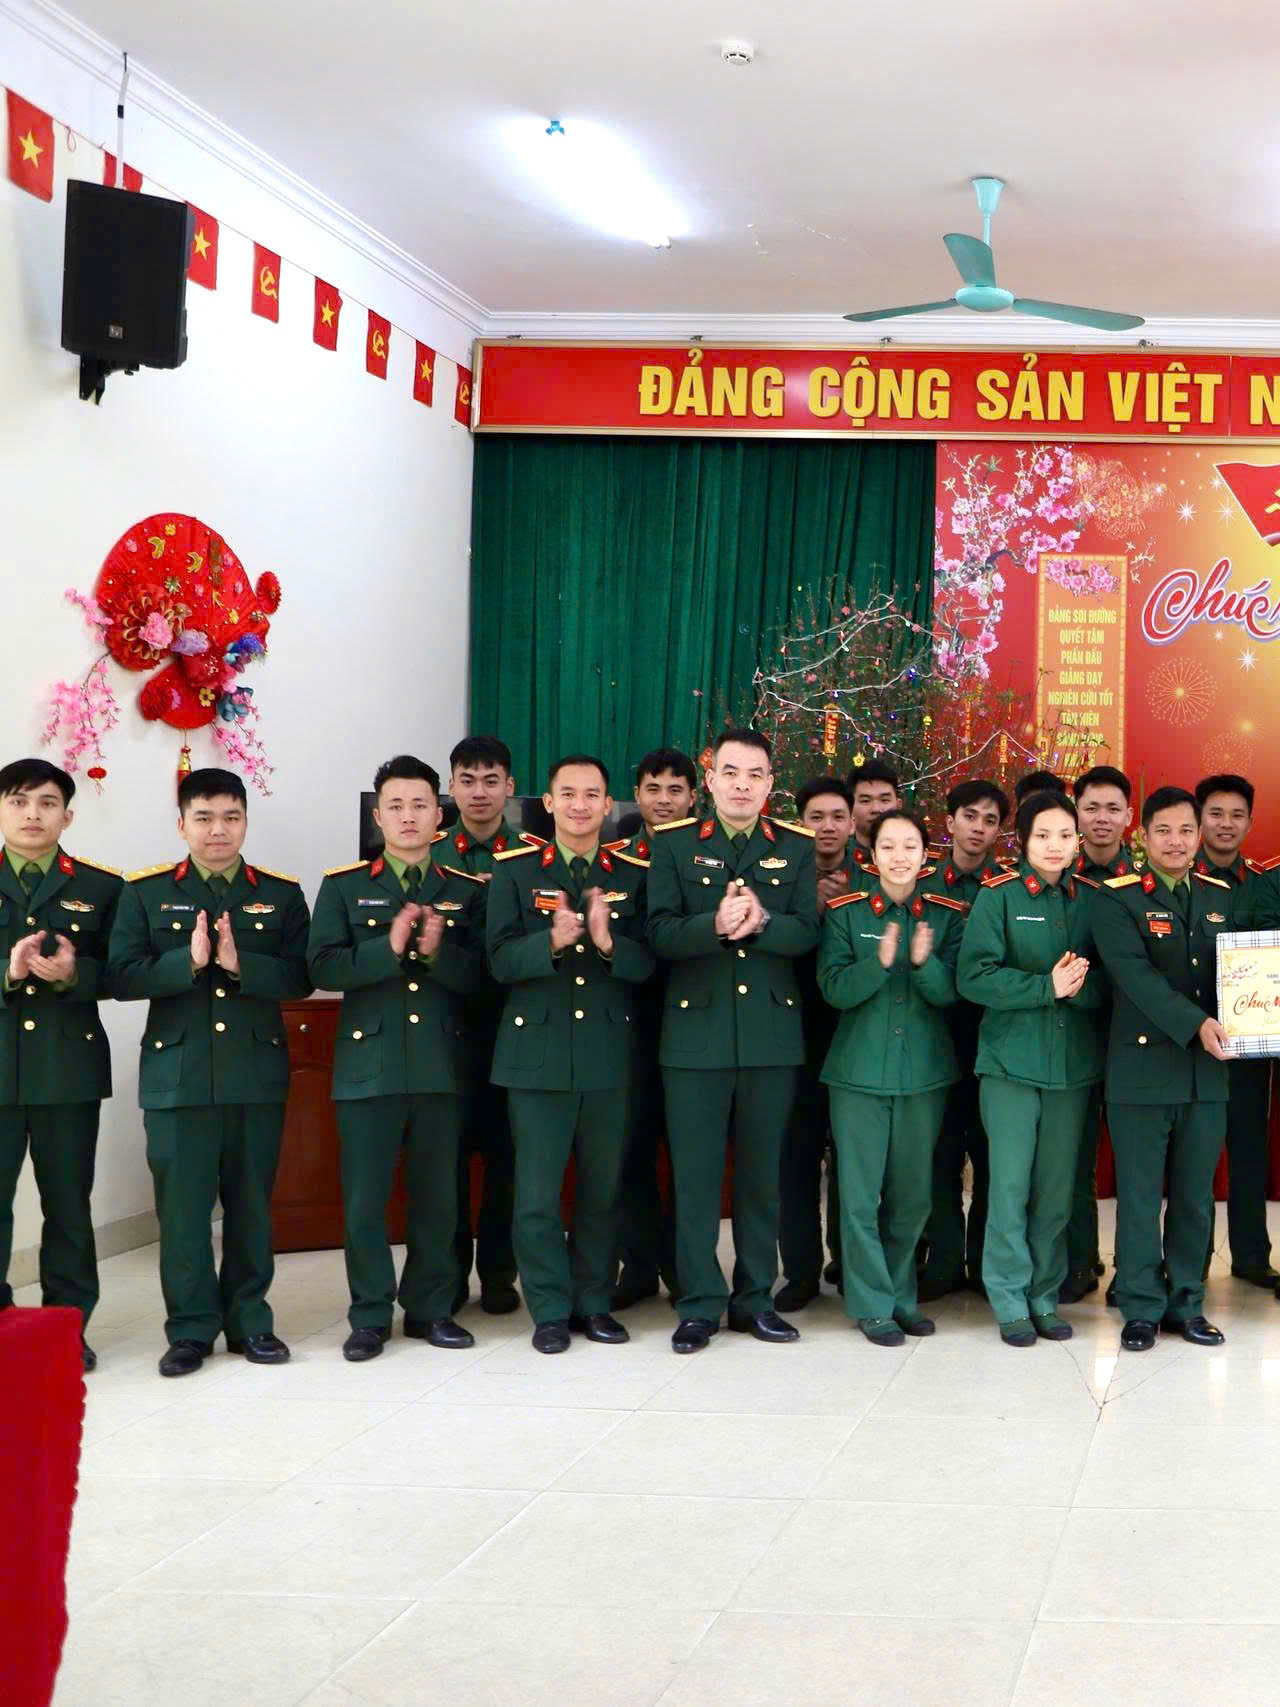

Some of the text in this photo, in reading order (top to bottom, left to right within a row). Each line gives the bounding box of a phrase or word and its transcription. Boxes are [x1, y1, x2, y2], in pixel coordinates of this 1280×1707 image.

[639, 348, 784, 417] ĐẢNG
[808, 357, 950, 427] CỘNG
[976, 352, 1084, 421] SẢN
[1108, 363, 1222, 433] VIỆT
[1072, 609, 1087, 624] SOI
[1087, 671, 1103, 688] DẠY
[1099, 688, 1113, 706] TỐT
